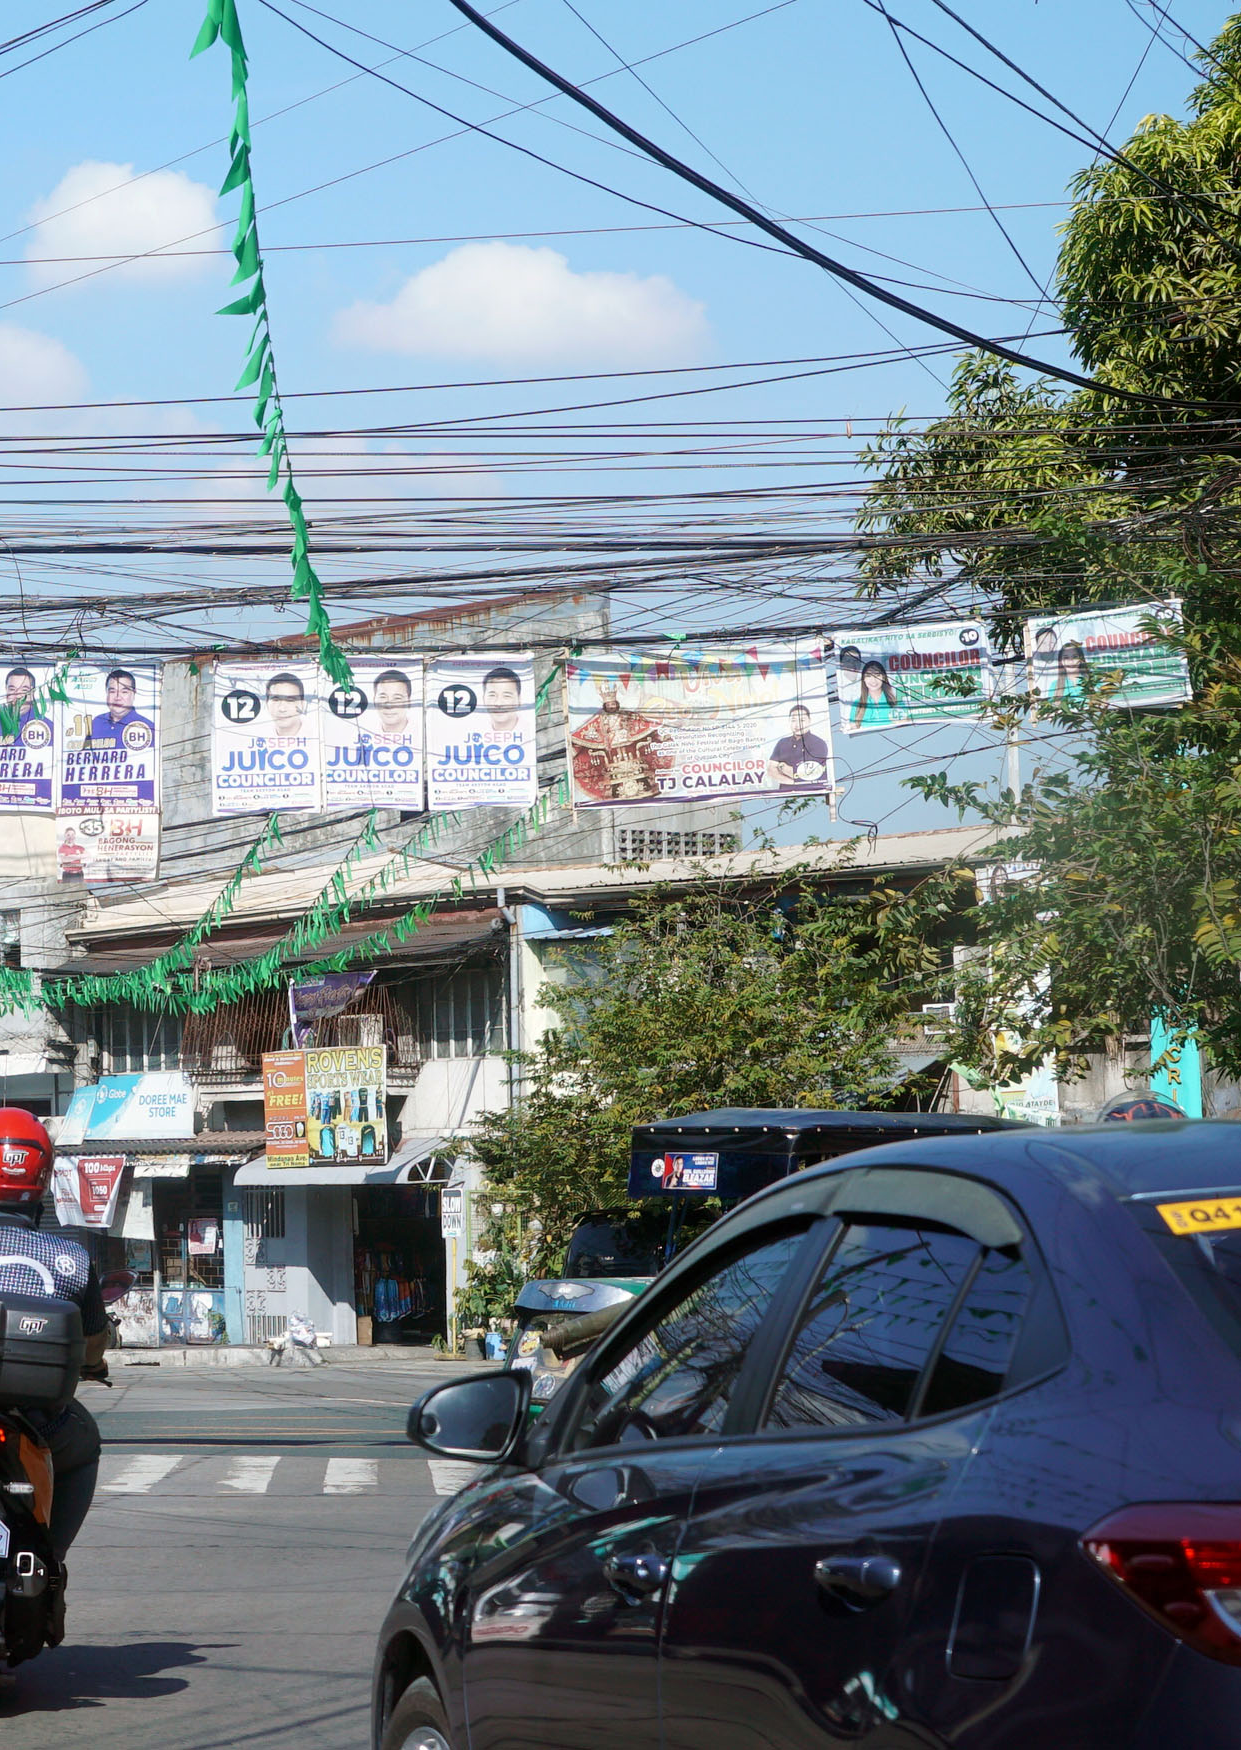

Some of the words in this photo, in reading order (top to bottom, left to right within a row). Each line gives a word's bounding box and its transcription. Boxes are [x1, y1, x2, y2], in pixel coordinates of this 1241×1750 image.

[889, 650, 981, 672] COUNCILOR
[227, 696, 255, 720] 12
[335, 691, 361, 714] 12
[443, 690, 471, 714] 12
[27, 730, 45, 740] BH
[129, 732, 145, 742] BH
[66, 750, 128, 766] BERNARD
[221, 748, 309, 772] JUICO
[327, 745, 413, 768] JUICO
[437, 743, 525, 766] JUICO
[65, 764, 145, 782] HERRERA
[682, 760, 765, 774] COUNCILOR
[217, 774, 313, 788] COUNCILOR
[327, 770, 417, 784] COUNCILOR
[433, 768, 529, 782] COUNCILOR
[657, 777, 677, 790] TJ
[683, 772, 765, 788] CALALAY
[110, 819, 143, 836] BH
[97, 844, 153, 852] HENERASYON
[307, 1048, 383, 1073] ROVENS
[307, 1072, 348, 1089] SPORTS
[109, 1089, 127, 1098] Globe
[139, 1095, 167, 1106] DOREE
[169, 1094, 187, 1104] MAE
[269, 1094, 304, 1106] FREE!
[149, 1107, 175, 1118] STORE
[84, 1162, 100, 1174] 100
[683, 1174, 715, 1183] ELEAZAR
[443, 1196, 461, 1213] SLOW
[443, 1214, 461, 1229] DOWN
